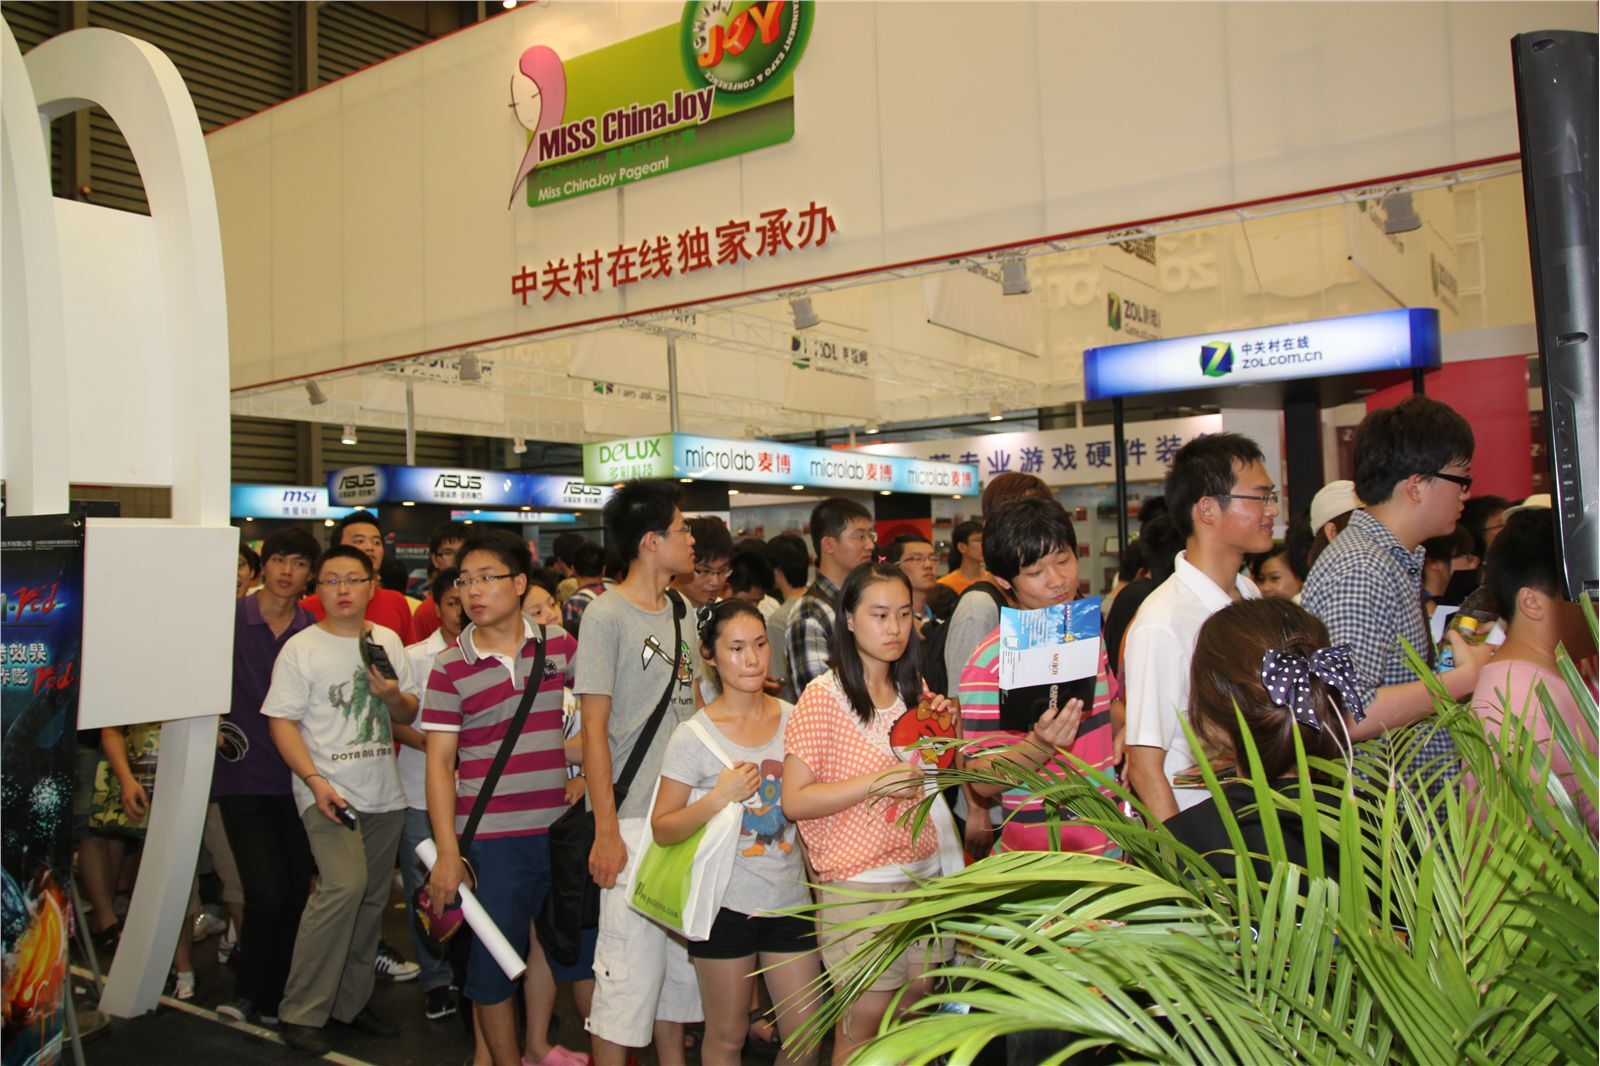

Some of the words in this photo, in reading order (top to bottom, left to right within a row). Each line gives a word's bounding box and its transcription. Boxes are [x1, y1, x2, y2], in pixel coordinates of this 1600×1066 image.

[697, 0, 785, 68] JOY
[783, 0, 800, 52] AINMENT
[764, 52, 785, 76] EXPO
[602, 86, 716, 143] ChinaJoy
[538, 186, 562, 201] Miss
[563, 172, 617, 195] ChinaJoy
[619, 155, 670, 181] Pageant
[510, 200, 837, 306] 中关村在线独家承办
[1241, 335, 1310, 355] 中关村在线
[685, 447, 755, 473] microlab
[758, 451, 792, 475] 麦博
[810, 457, 865, 482] microlab
[866, 462, 893, 483] 麦博
[339, 473, 376, 489] ASUS
[434, 474, 482, 490] ASUS
[563, 481, 601, 495] ASUS
[907, 467, 950, 486] microlab
[282, 490, 317, 502] msi
[331, 750, 360, 762] DOTA
